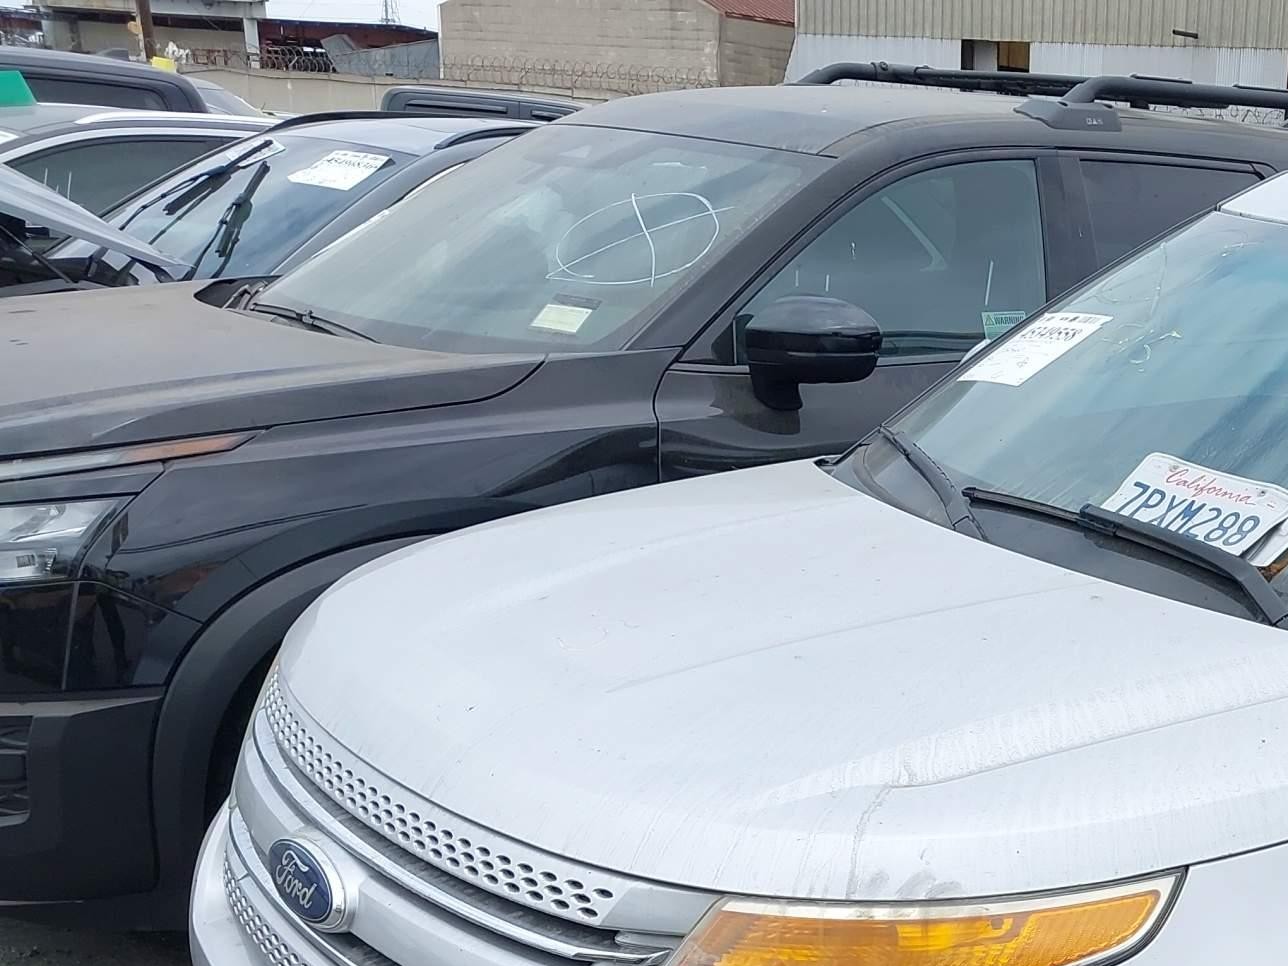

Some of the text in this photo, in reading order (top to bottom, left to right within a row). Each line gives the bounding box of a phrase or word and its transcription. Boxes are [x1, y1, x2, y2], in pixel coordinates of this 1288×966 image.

[1118, 481, 1261, 547] 7PXM288
[1165, 468, 1256, 506] California
[275, 849, 318, 909] Ford
